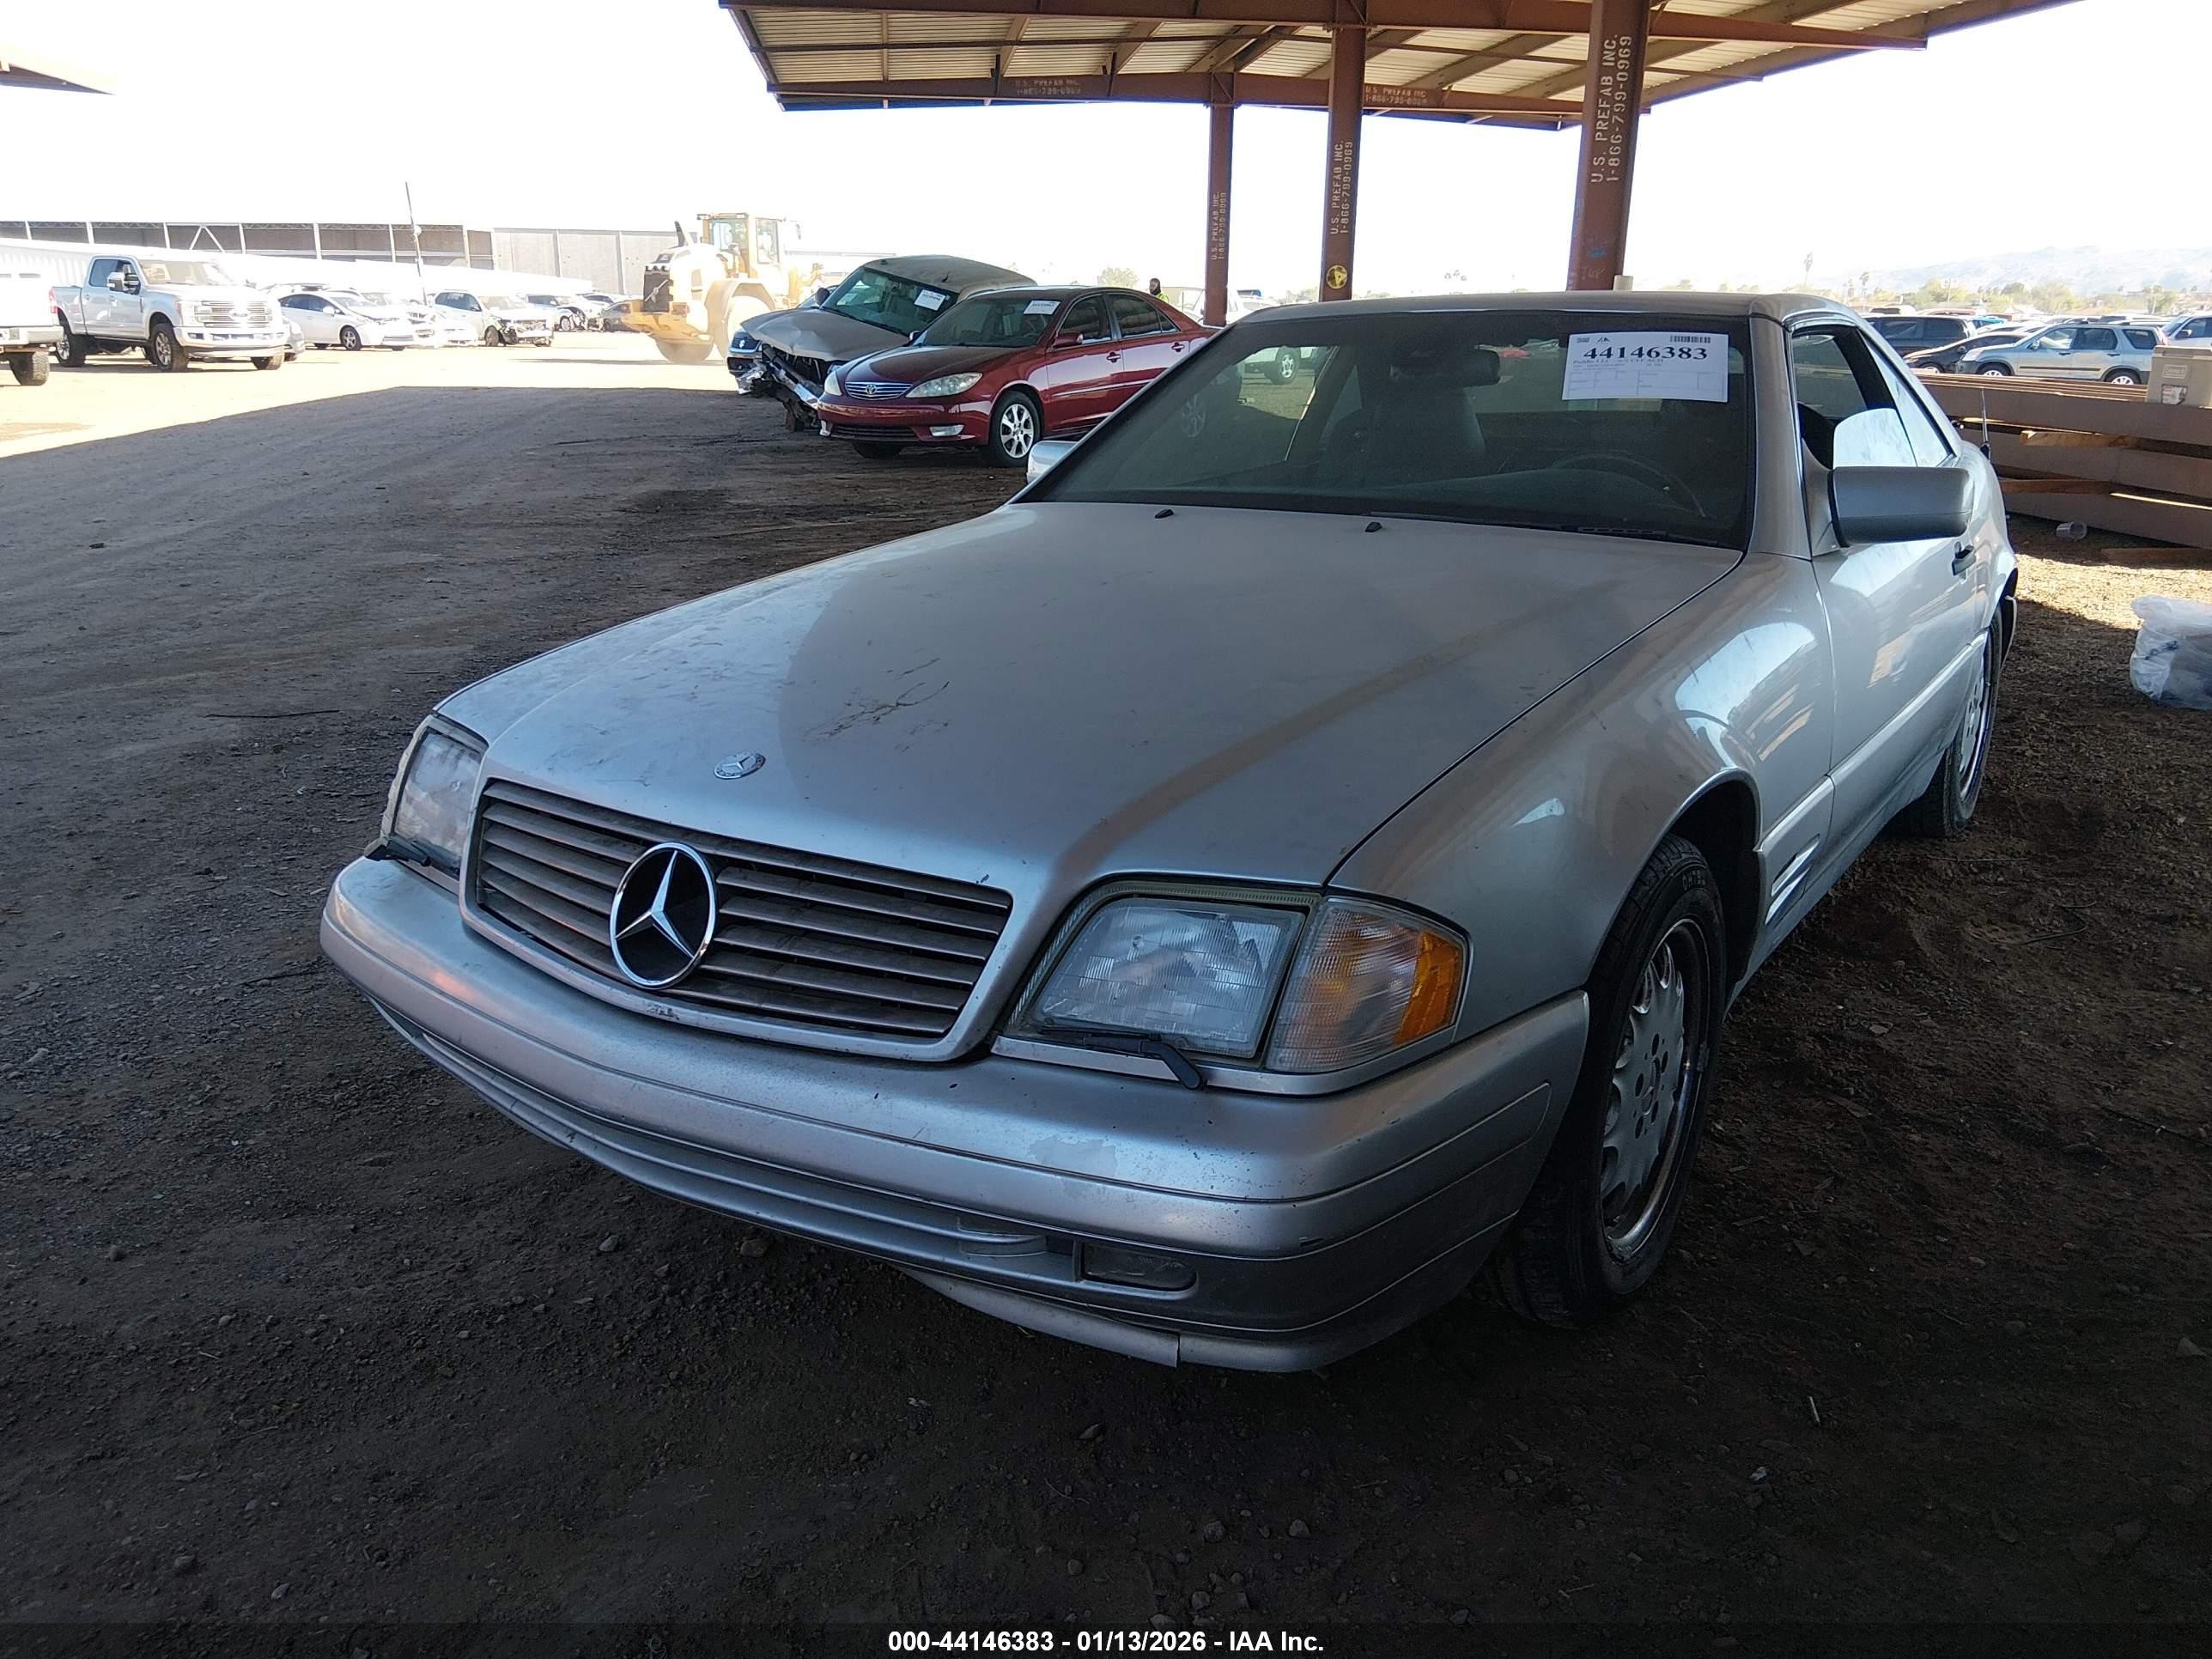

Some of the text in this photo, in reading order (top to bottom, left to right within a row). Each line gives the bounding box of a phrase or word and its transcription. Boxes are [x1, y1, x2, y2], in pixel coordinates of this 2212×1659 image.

[1591, 34, 1619, 183] U.S. PREFAB INC.
[1607, 36, 1632, 182] 1-866-799-0969
[1330, 140, 1344, 234] U.S. PREFAB INC.
[1583, 346, 1708, 361] 44146383
